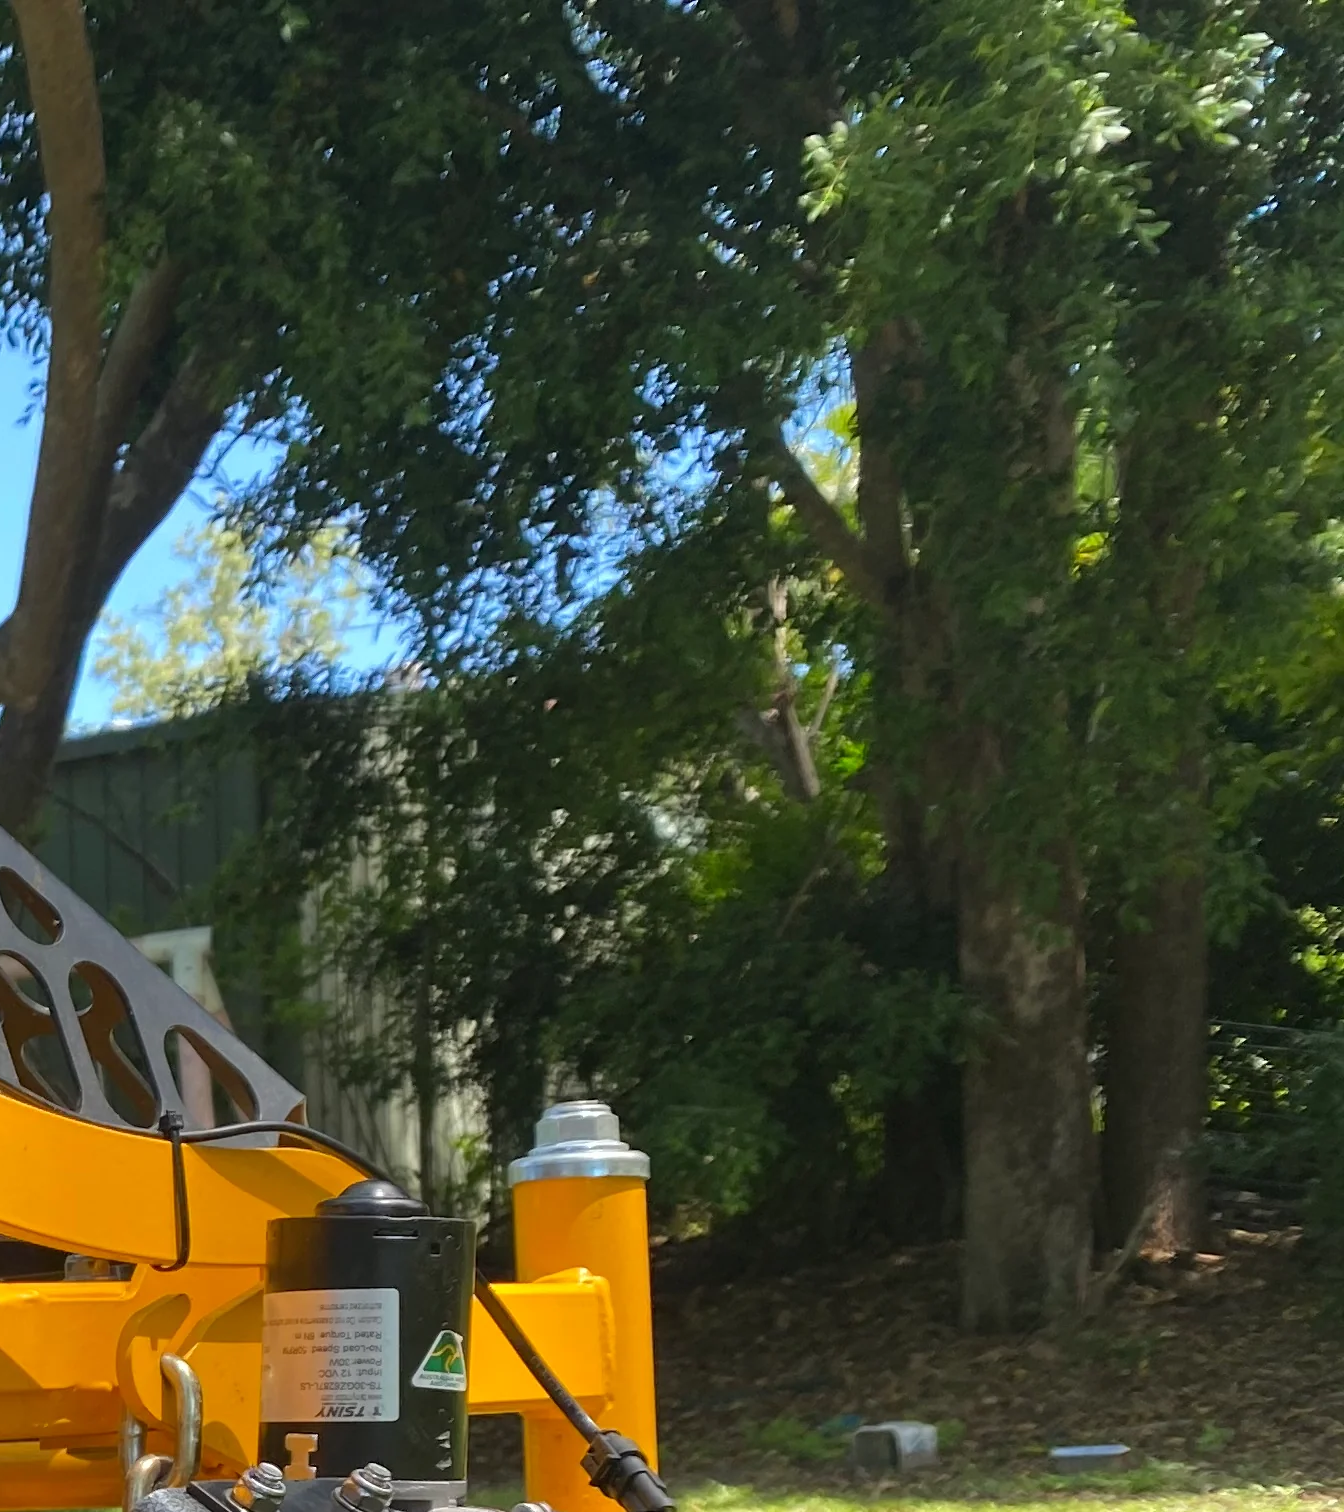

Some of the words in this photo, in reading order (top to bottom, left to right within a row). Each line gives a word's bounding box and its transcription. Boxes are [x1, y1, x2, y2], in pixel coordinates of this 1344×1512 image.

[354, 1331, 383, 1340] Rated
[343, 1344, 383, 1353] No-Load
[318, 1369, 339, 1379] VDC
[341, 1368, 352, 1378] 12
[315, 1405, 365, 1418] TSINY
